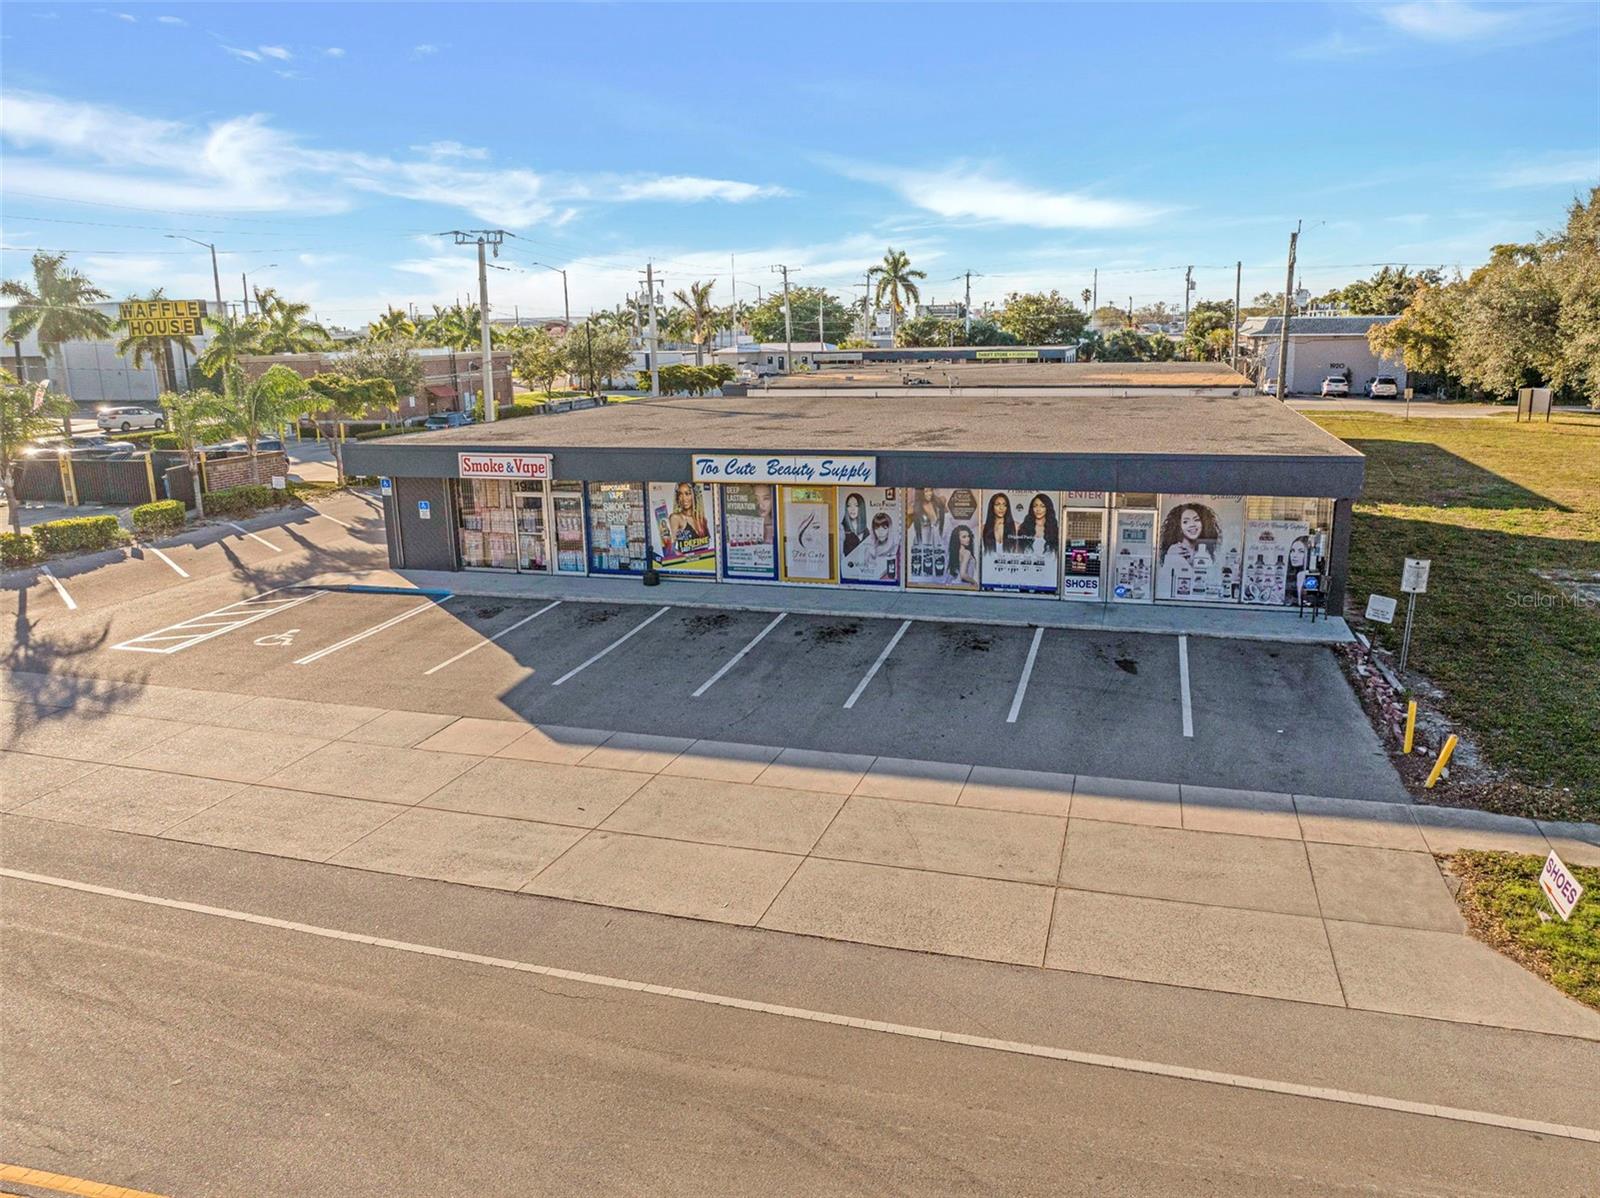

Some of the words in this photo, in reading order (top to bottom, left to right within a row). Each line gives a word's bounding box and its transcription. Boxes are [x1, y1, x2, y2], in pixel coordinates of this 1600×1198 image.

[121, 302, 198, 318] WAFFLE
[131, 320, 194, 335] HOUSE
[463, 458, 504, 472] Smoke
[506, 462, 514, 473] &
[513, 458, 545, 477] Vape
[696, 459, 719, 475] Too
[725, 458, 756, 475] Cute
[767, 459, 814, 481] Beauty
[819, 460, 871, 481] Supply
[1068, 491, 1102, 499] ENTER
[602, 503, 630, 512] SMOKE
[607, 513, 628, 521] SHOP
[1065, 579, 1098, 589] SHOES
[1546, 858, 1577, 904] SHOES
